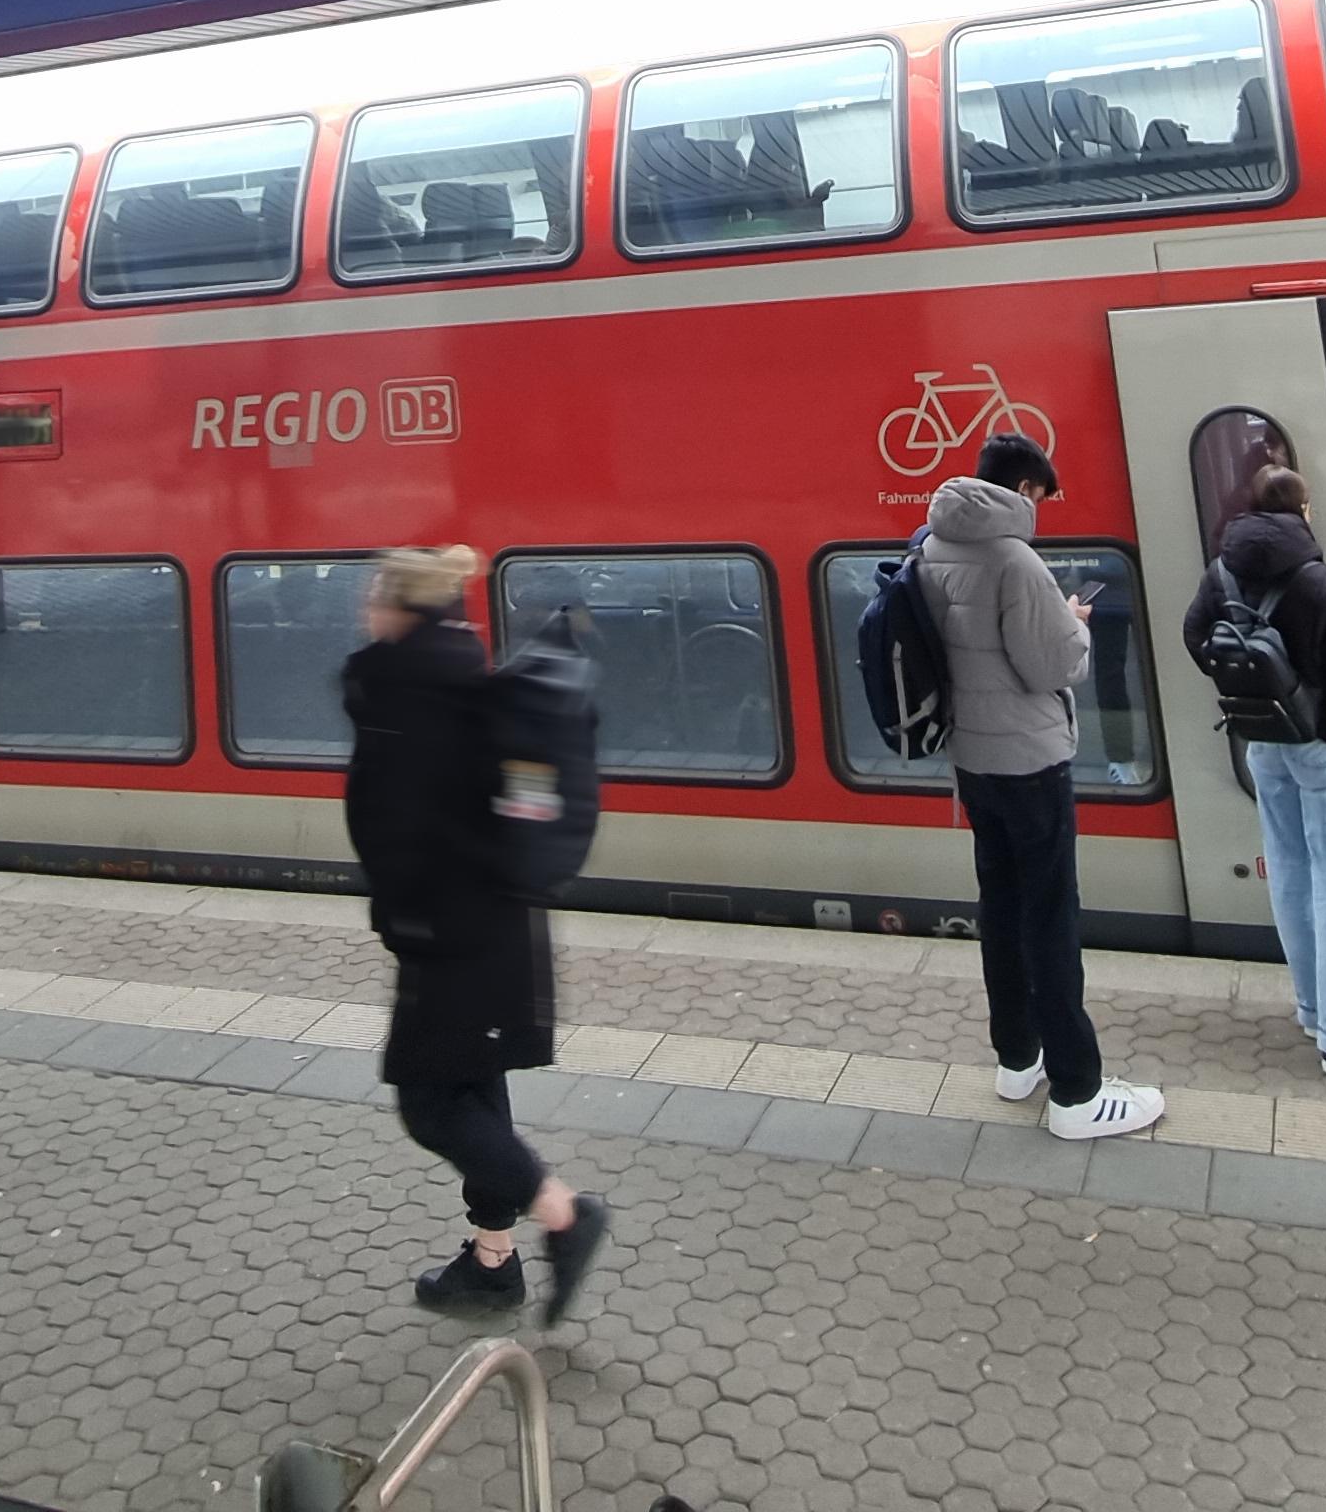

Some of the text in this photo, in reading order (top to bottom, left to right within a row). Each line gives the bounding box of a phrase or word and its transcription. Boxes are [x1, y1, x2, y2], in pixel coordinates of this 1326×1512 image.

[191, 388, 451, 449] REGIO DB
[877, 490, 933, 505] Fahrrad
